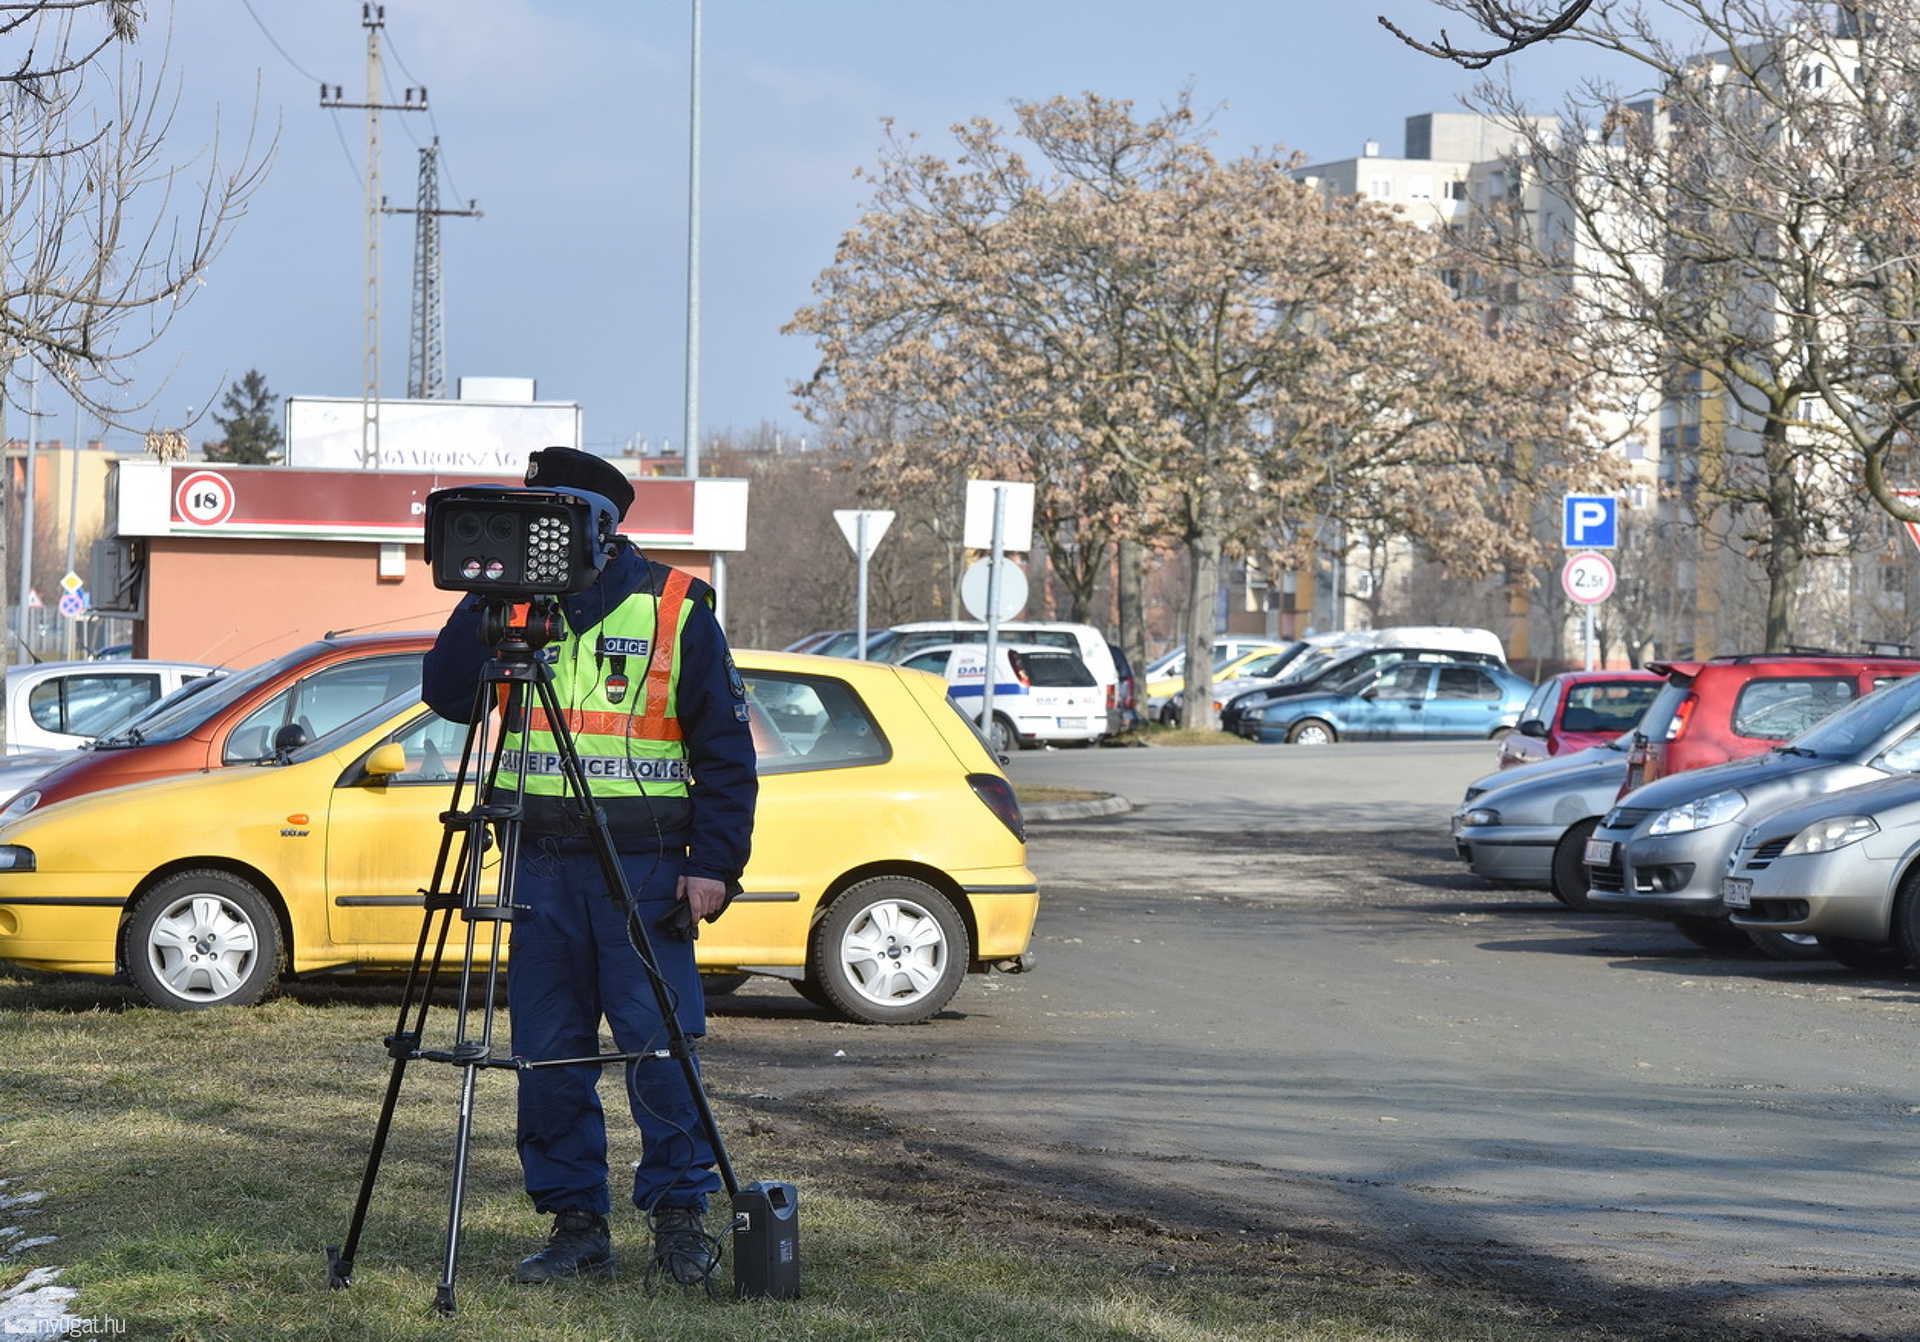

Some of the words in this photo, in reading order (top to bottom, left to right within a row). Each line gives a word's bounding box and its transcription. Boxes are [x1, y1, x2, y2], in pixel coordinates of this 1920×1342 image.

[194, 492, 218, 509] 18
[1574, 502, 1607, 541] P
[604, 639, 648, 654] OLICE
[500, 752, 538, 771] OLIE
[545, 756, 616, 776] PICE
